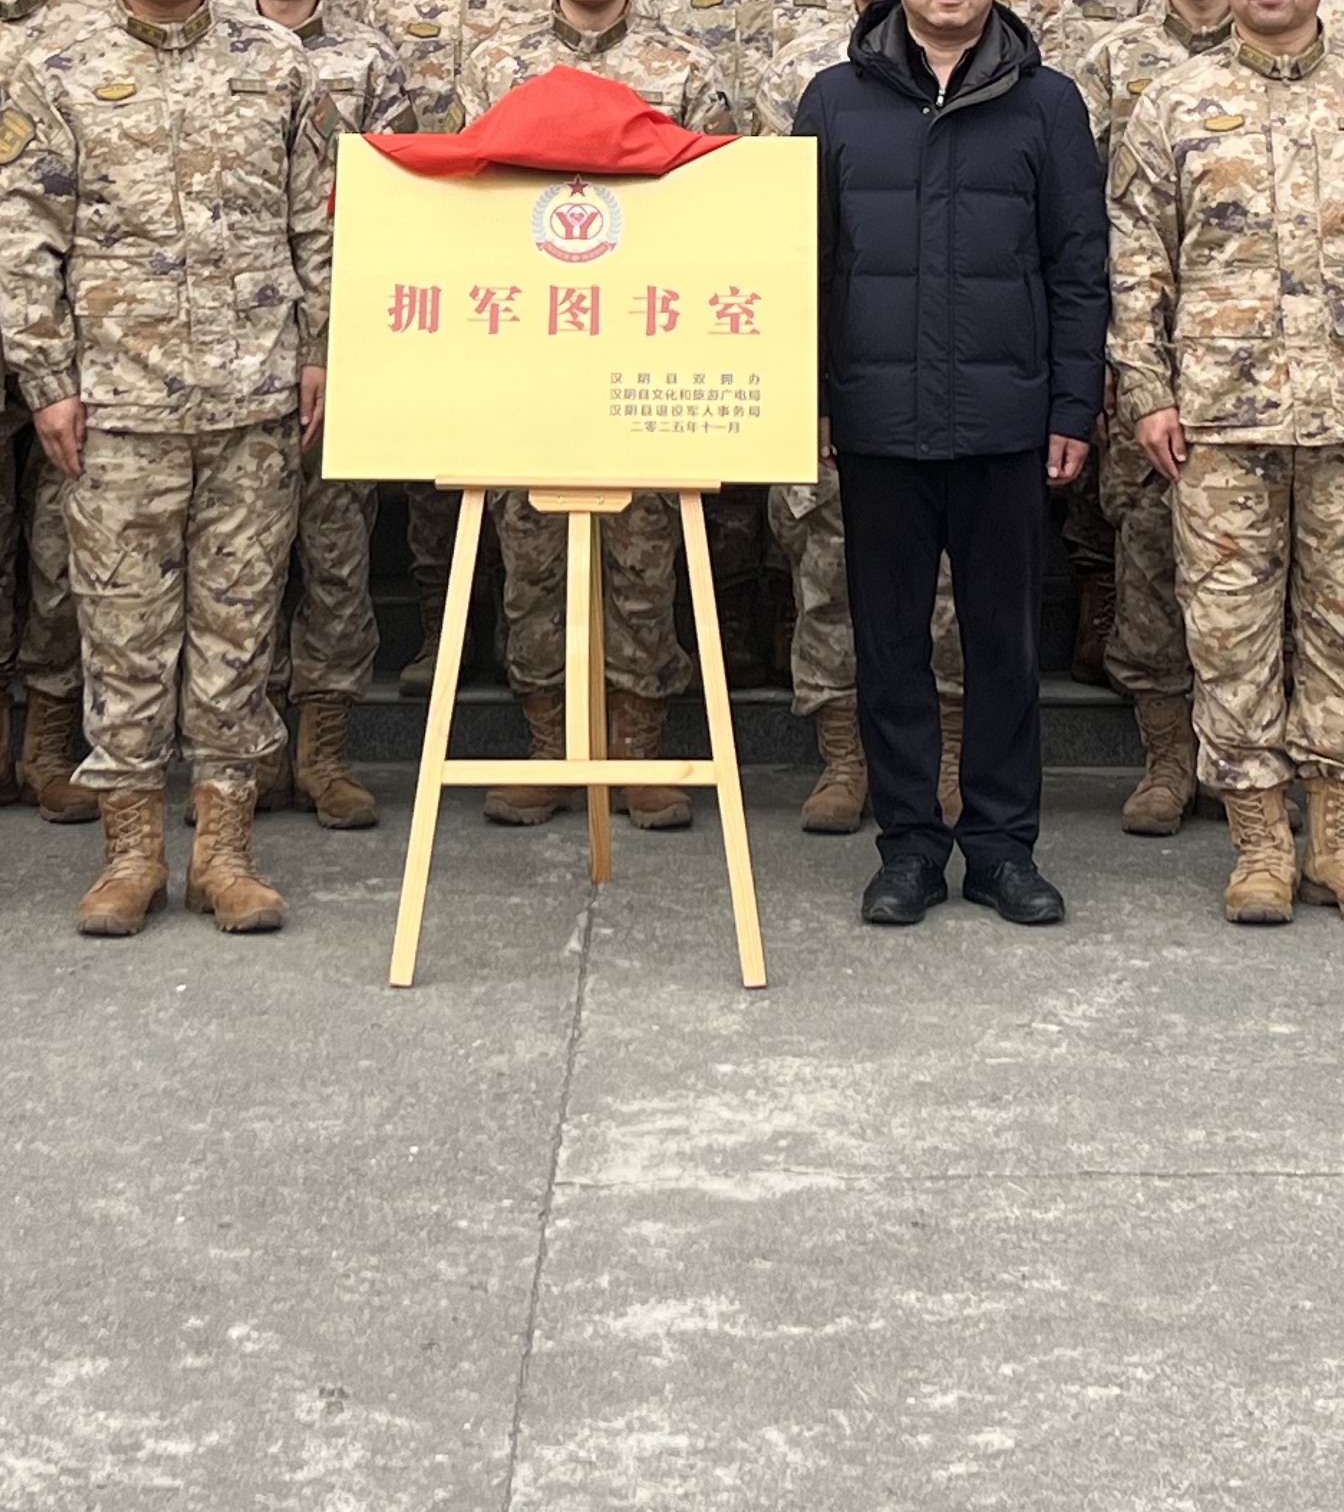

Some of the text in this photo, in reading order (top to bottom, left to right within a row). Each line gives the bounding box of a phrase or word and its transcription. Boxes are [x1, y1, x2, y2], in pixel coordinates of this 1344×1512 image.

[387, 283, 762, 337] 拥军图书室
[609, 388, 761, 401] 汉阴县文化和旅游广电局
[609, 404, 761, 417] 汉阴县退役军人事务局
[630, 420, 741, 434] 二零二五年十一月
